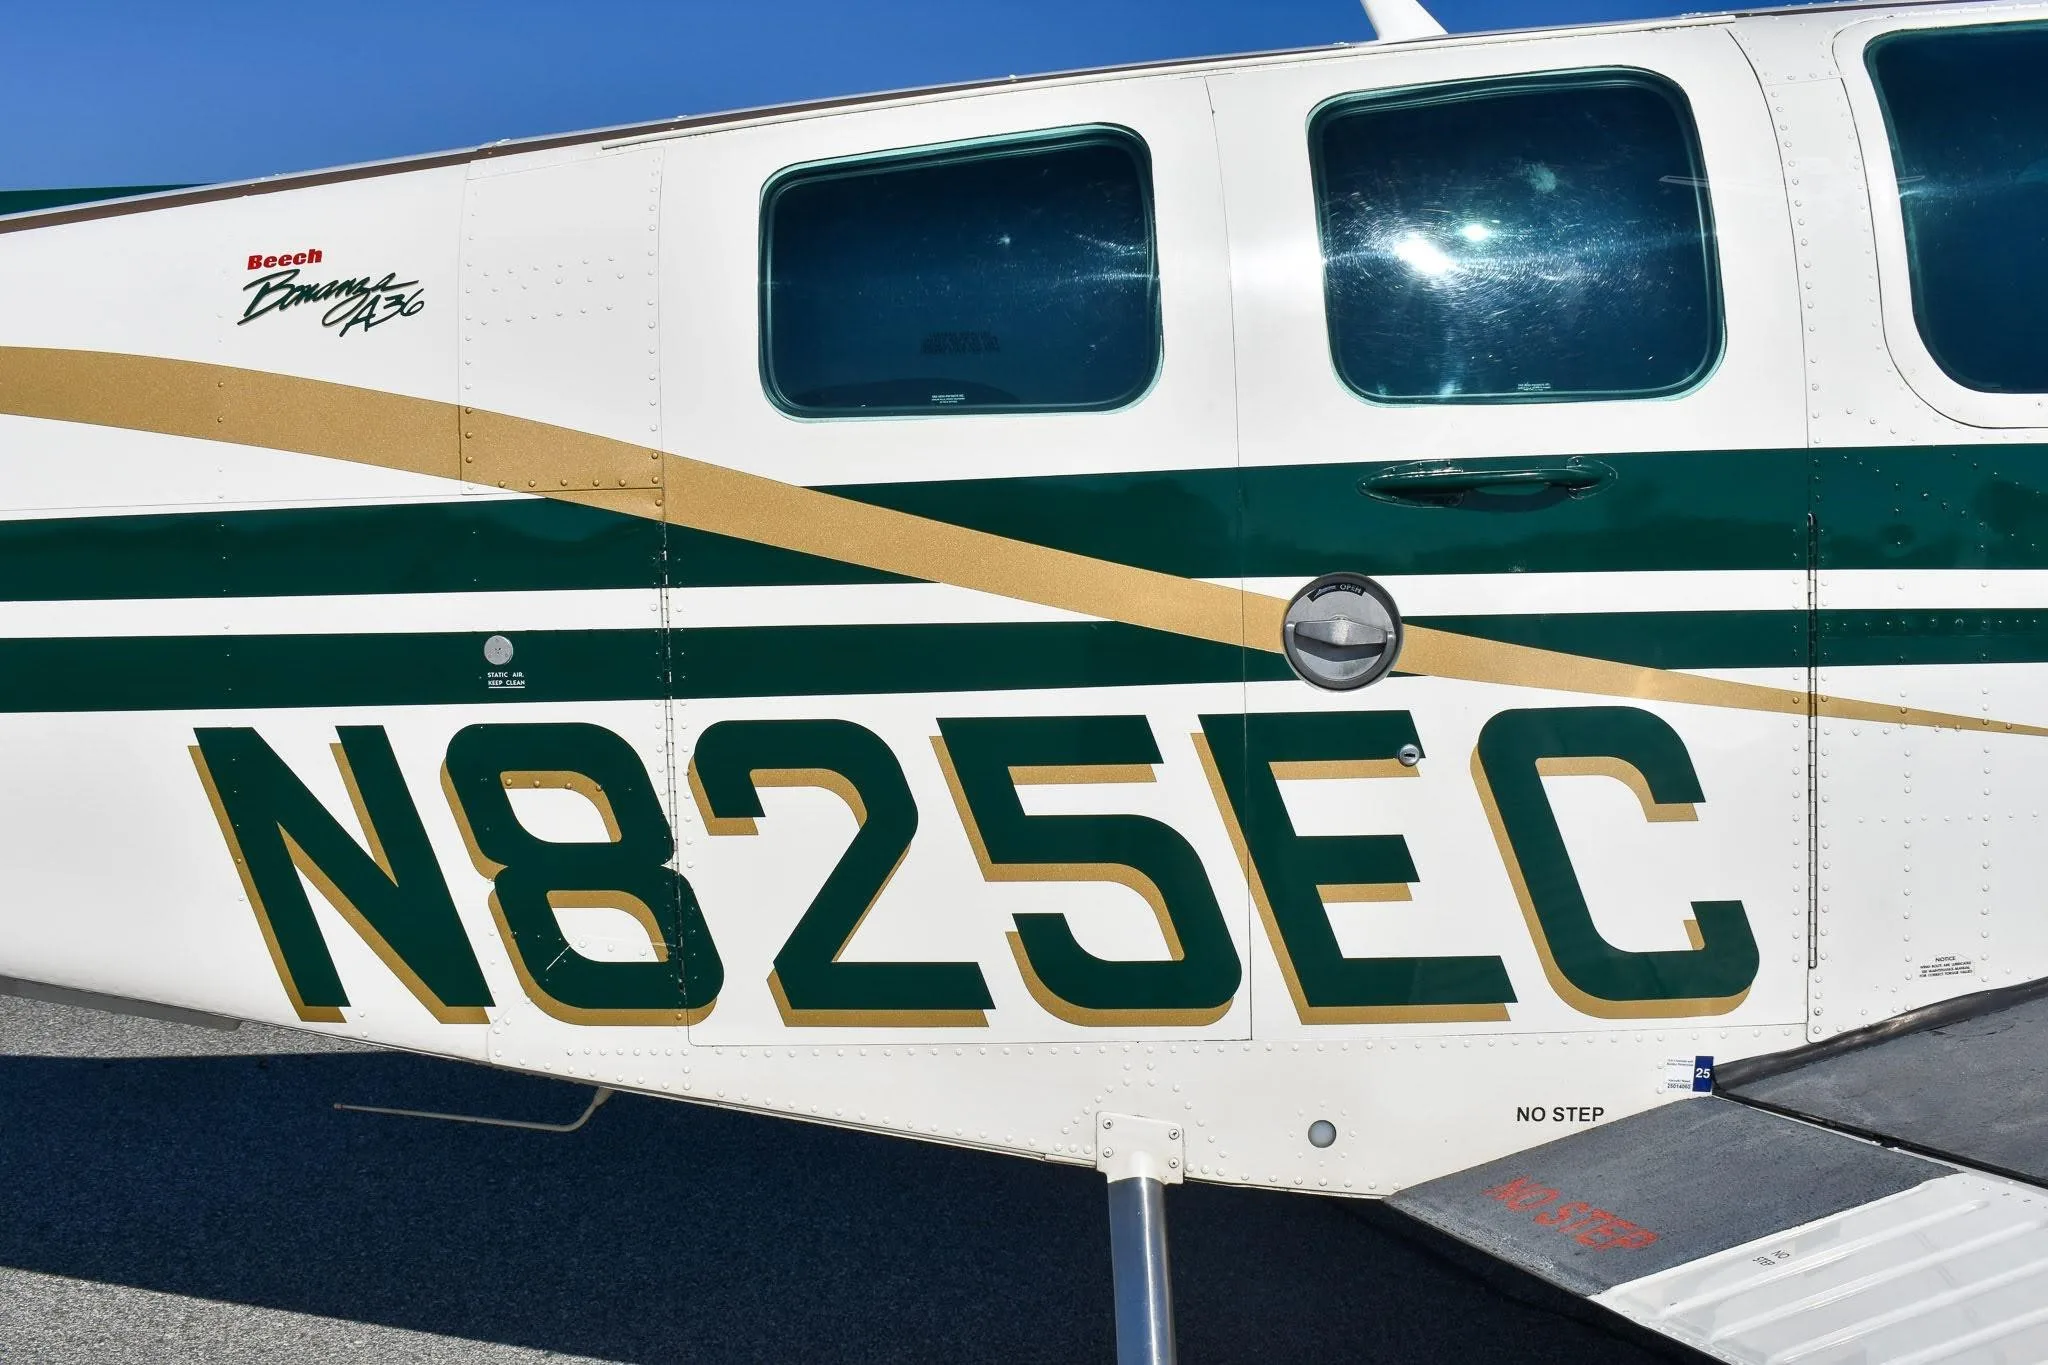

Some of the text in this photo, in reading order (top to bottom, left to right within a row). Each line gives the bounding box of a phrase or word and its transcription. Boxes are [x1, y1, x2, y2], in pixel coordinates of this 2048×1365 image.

[247, 248, 323, 271] Beech
[236, 268, 419, 328] Bonanza
[338, 288, 425, 338] A36
[1339, 583, 1362, 594] OPEN
[188, 705, 1761, 1028] N825EC
[1696, 1068, 1710, 1078] 25
[1516, 1106, 1605, 1122] NO STEP
[1481, 1175, 1658, 1250] NO STEP
[1752, 1256, 1776, 1266] STEP
[1771, 1250, 1790, 1259] NO
